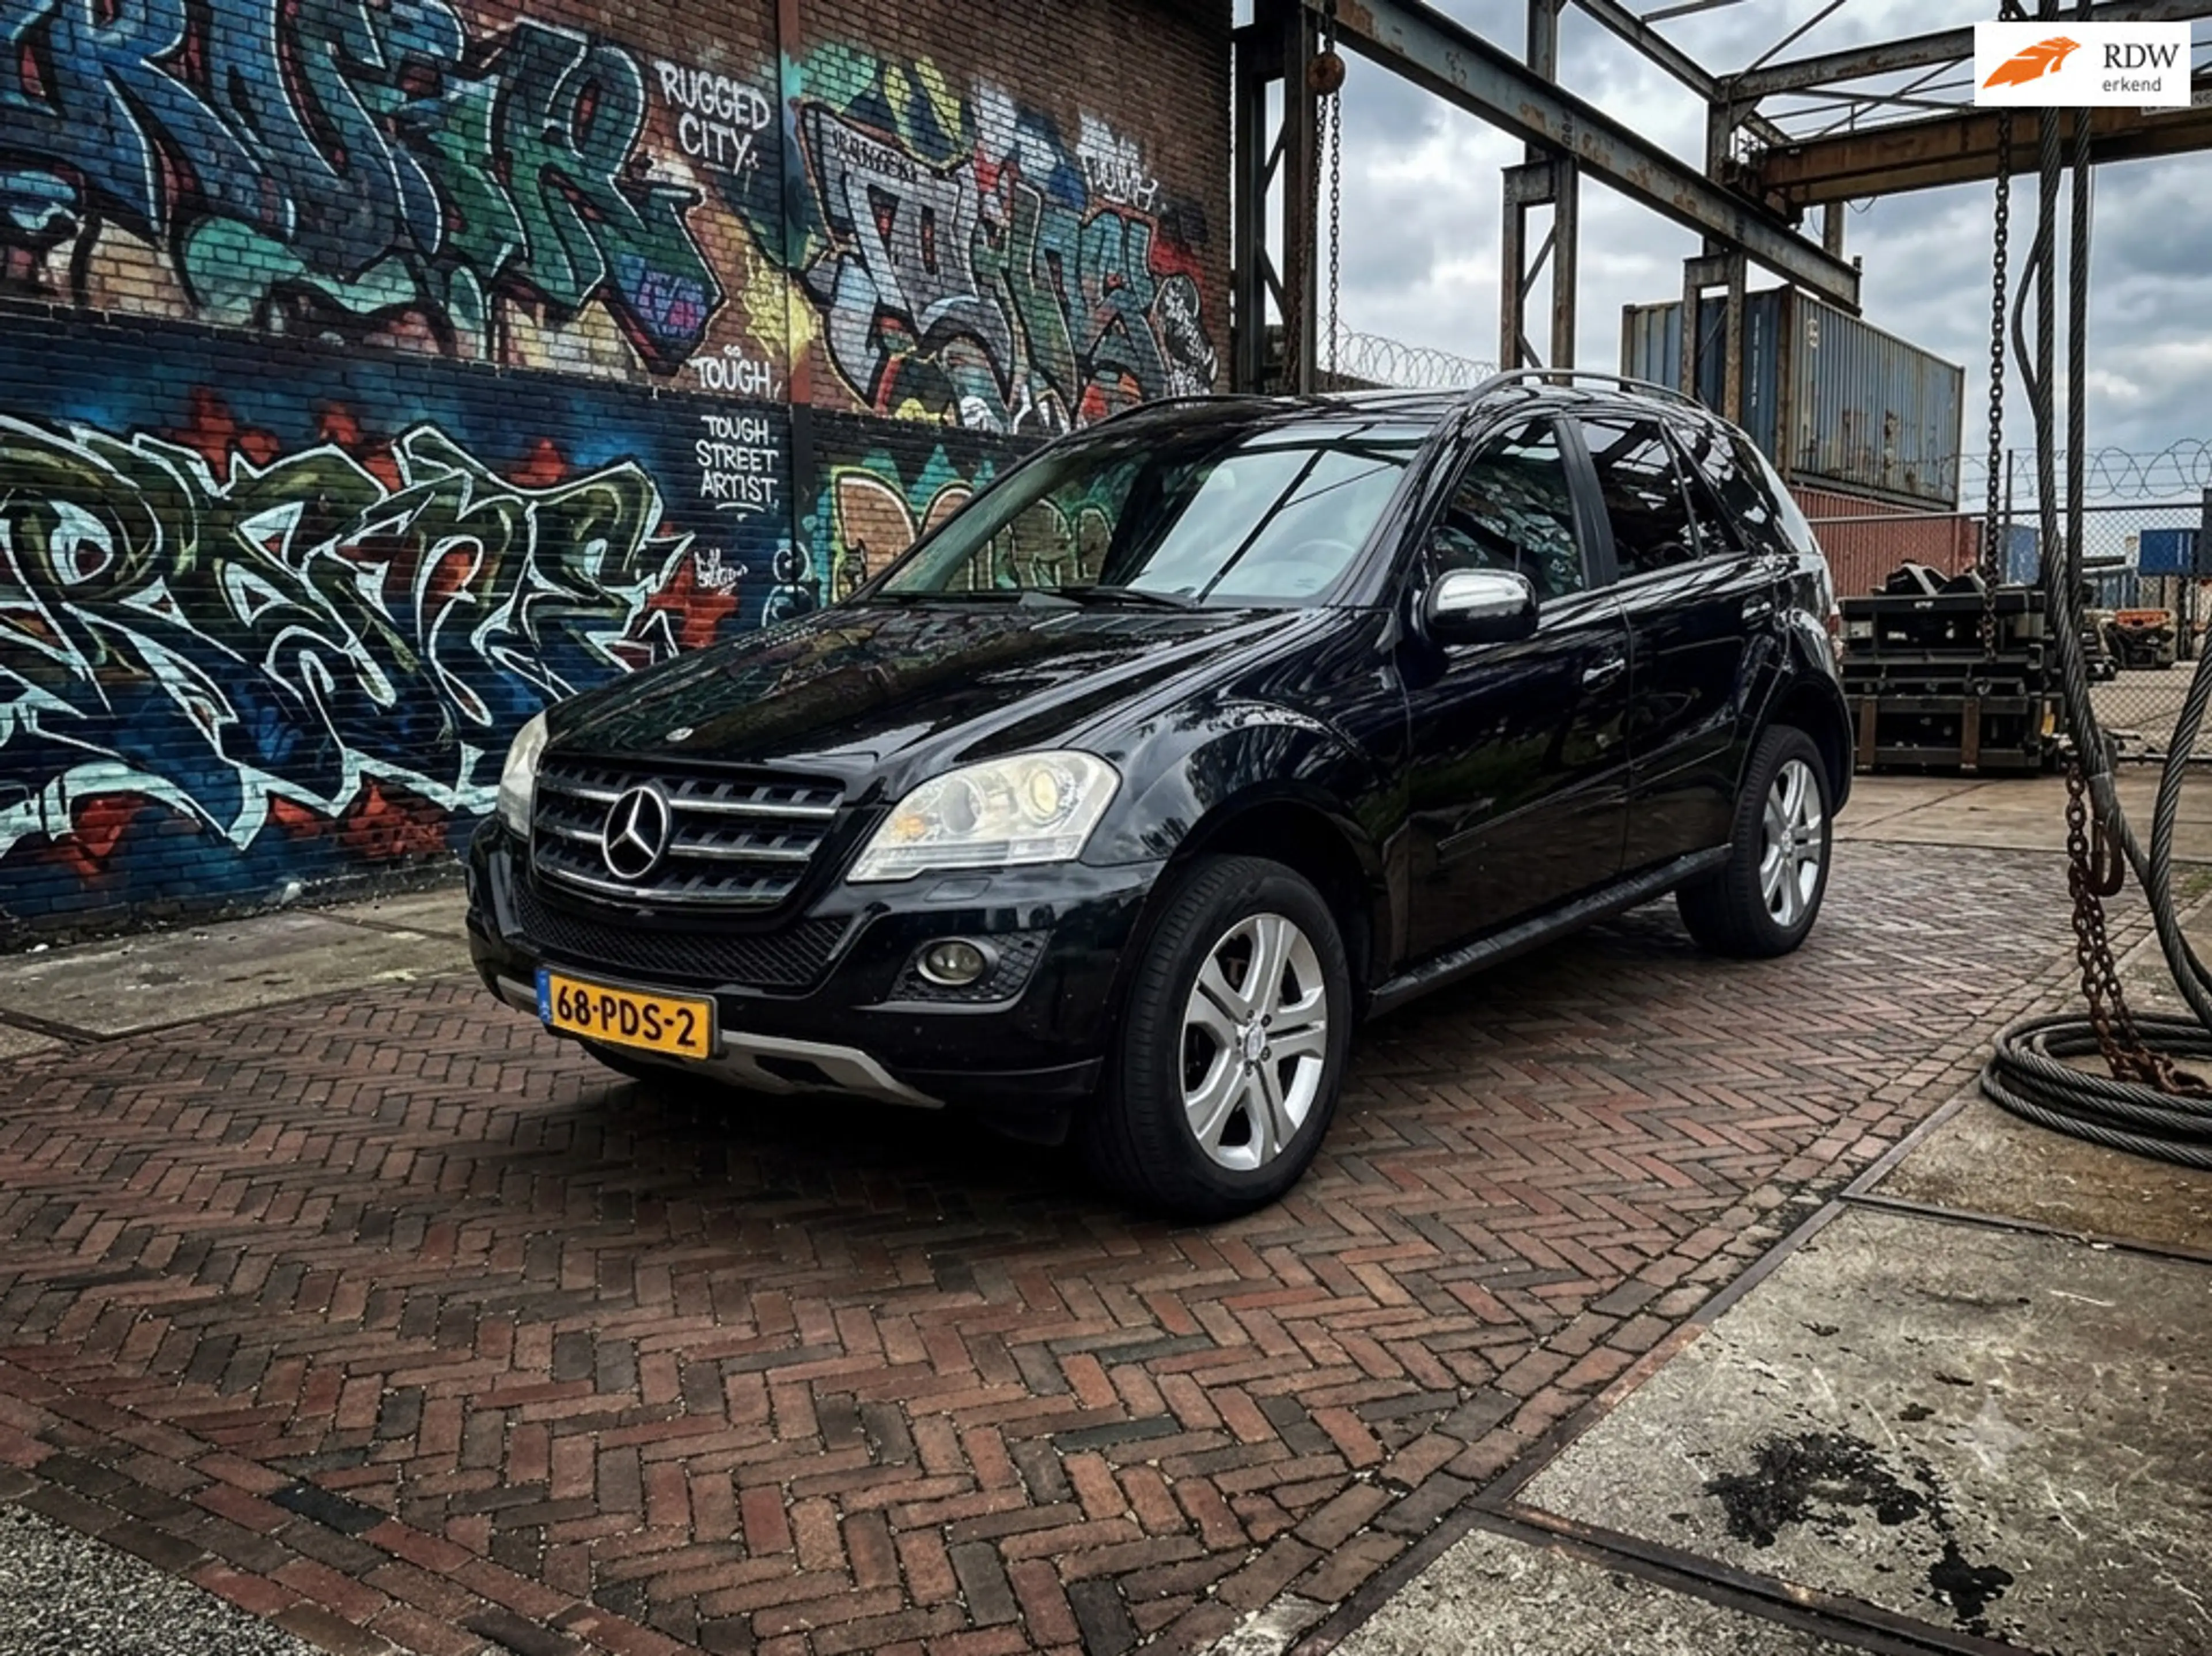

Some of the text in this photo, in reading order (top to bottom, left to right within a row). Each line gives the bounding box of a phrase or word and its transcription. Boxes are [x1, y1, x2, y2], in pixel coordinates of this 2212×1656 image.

[653, 59, 771, 130] RUGGED
[700, 414, 770, 446] TOUGH
[695, 438, 779, 472] STREET
[556, 985, 696, 1048] 68-PDS-2
